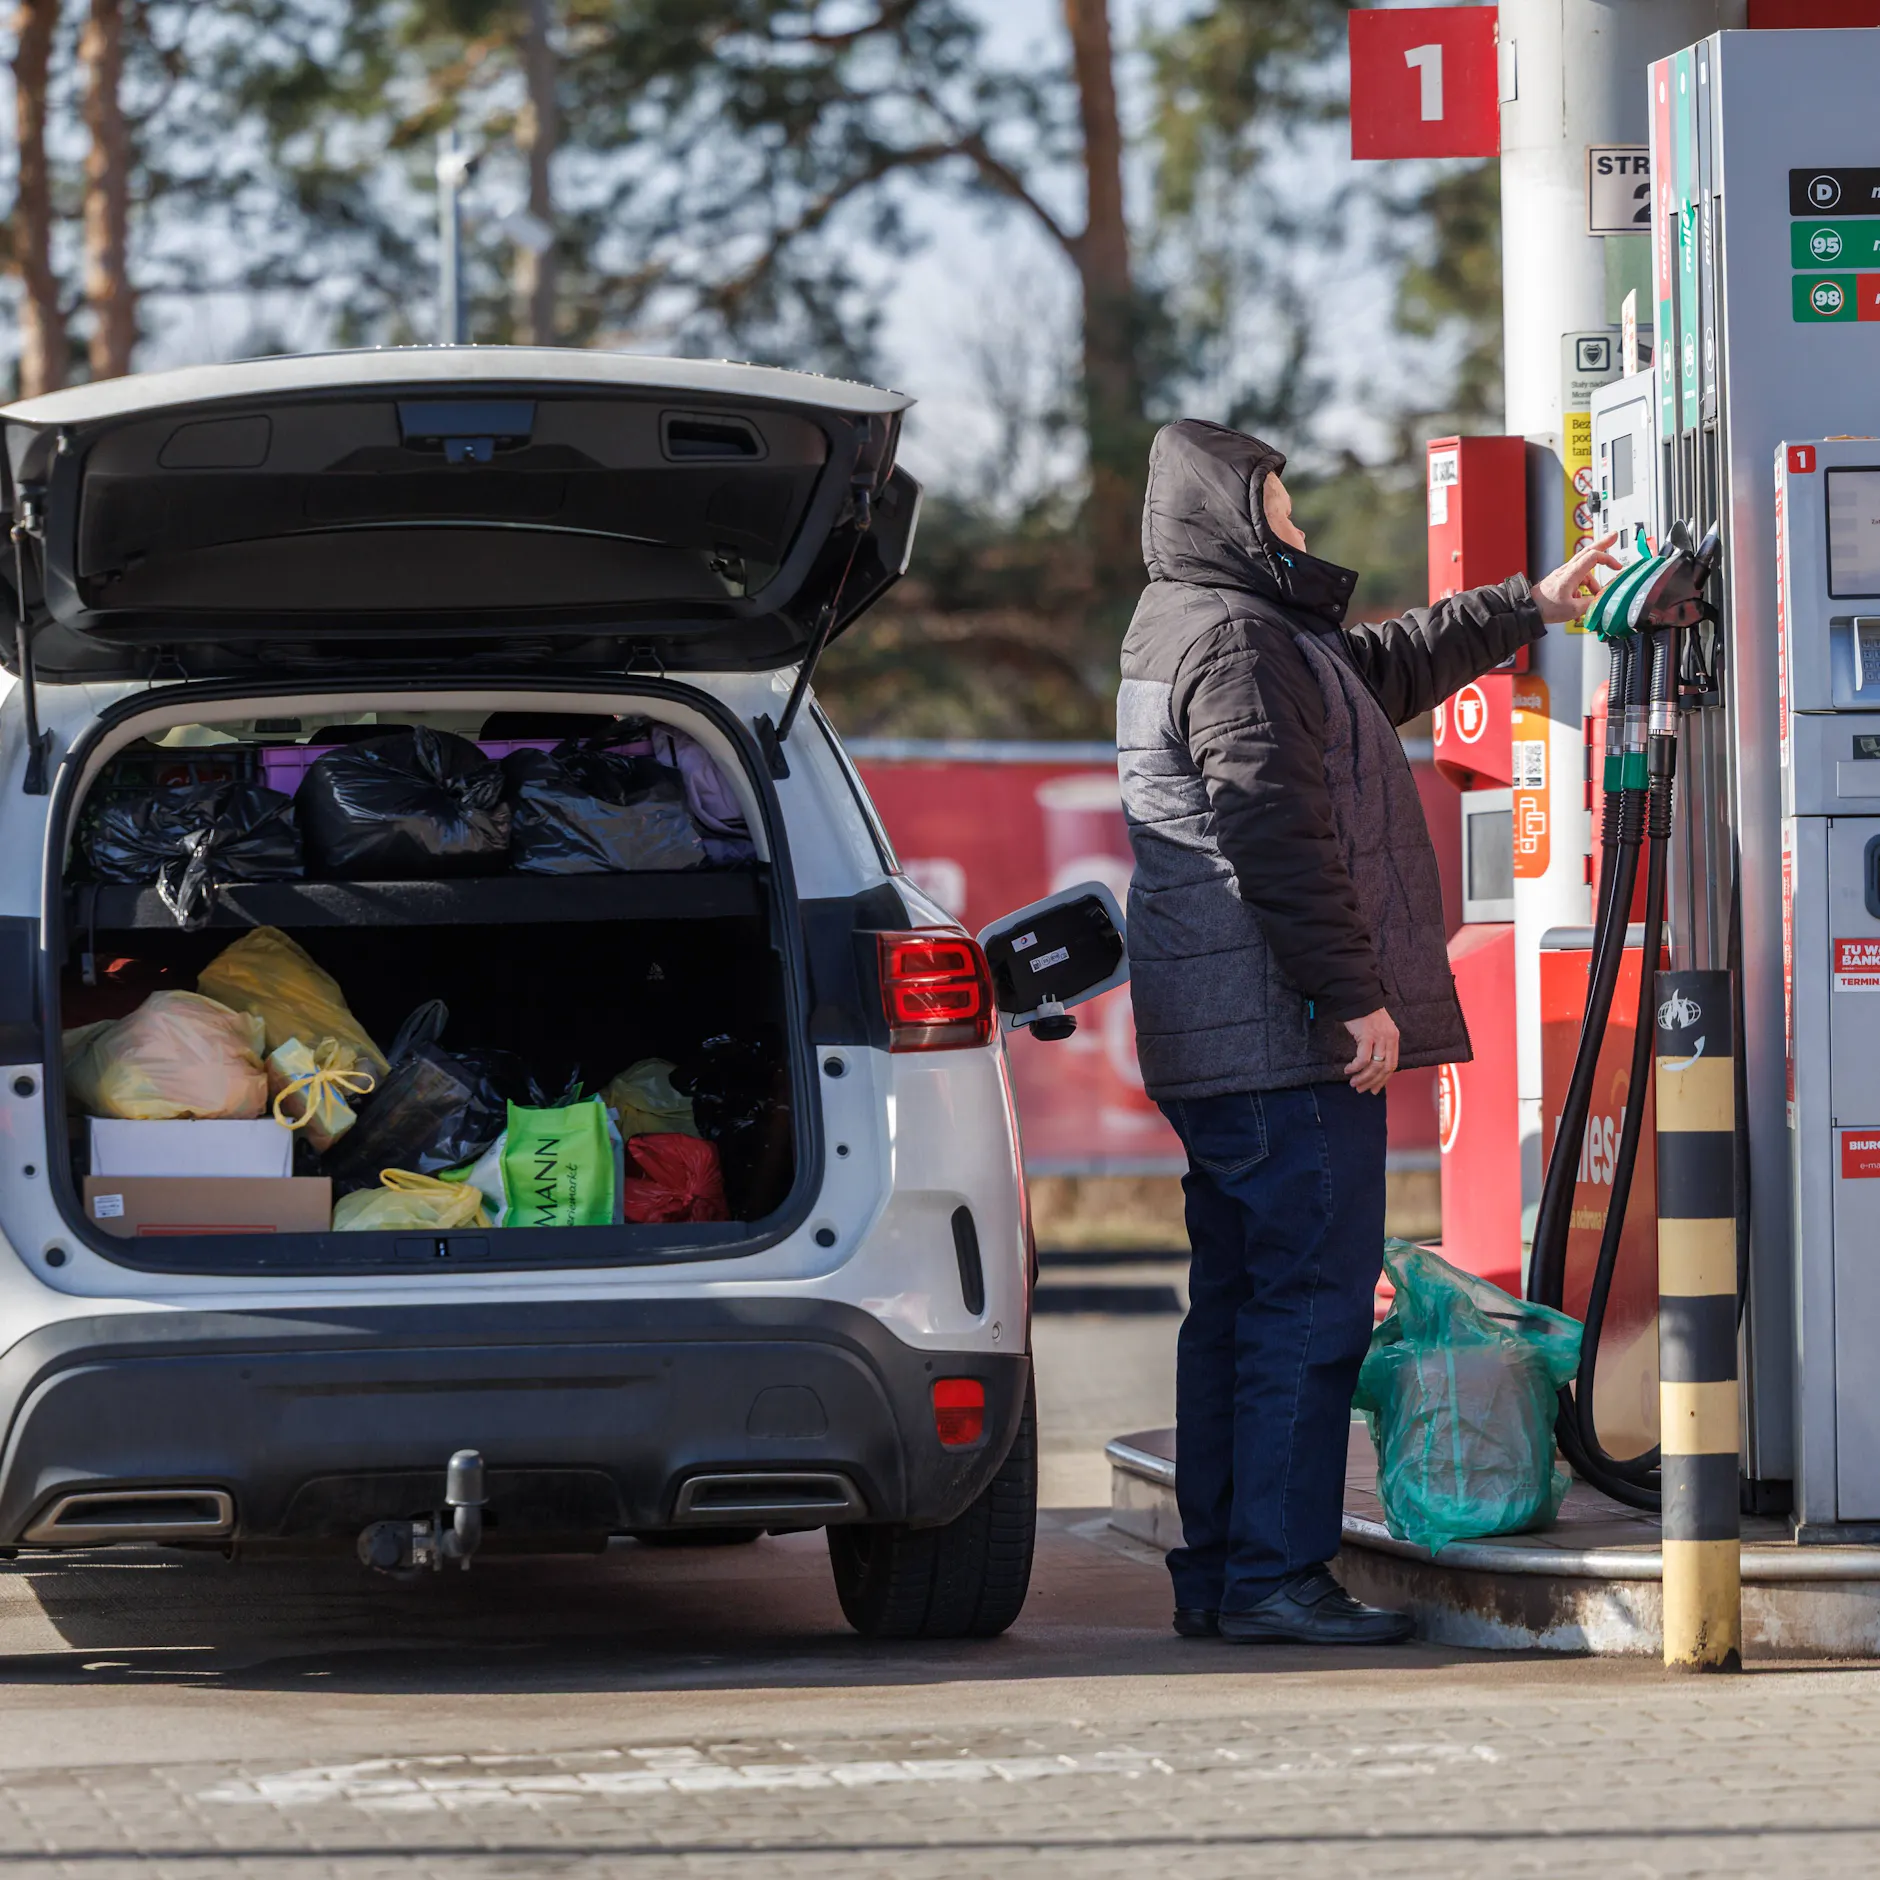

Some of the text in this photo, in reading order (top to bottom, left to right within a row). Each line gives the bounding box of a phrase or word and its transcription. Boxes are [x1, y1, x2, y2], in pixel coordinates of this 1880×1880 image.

[1404, 44, 1444, 122] 1
[1816, 184, 1833, 201] D
[1812, 236, 1840, 254] 95
[1814, 290, 1840, 307] 98
[1797, 450, 1807, 469] 1
[1842, 945, 1862, 956] TU
